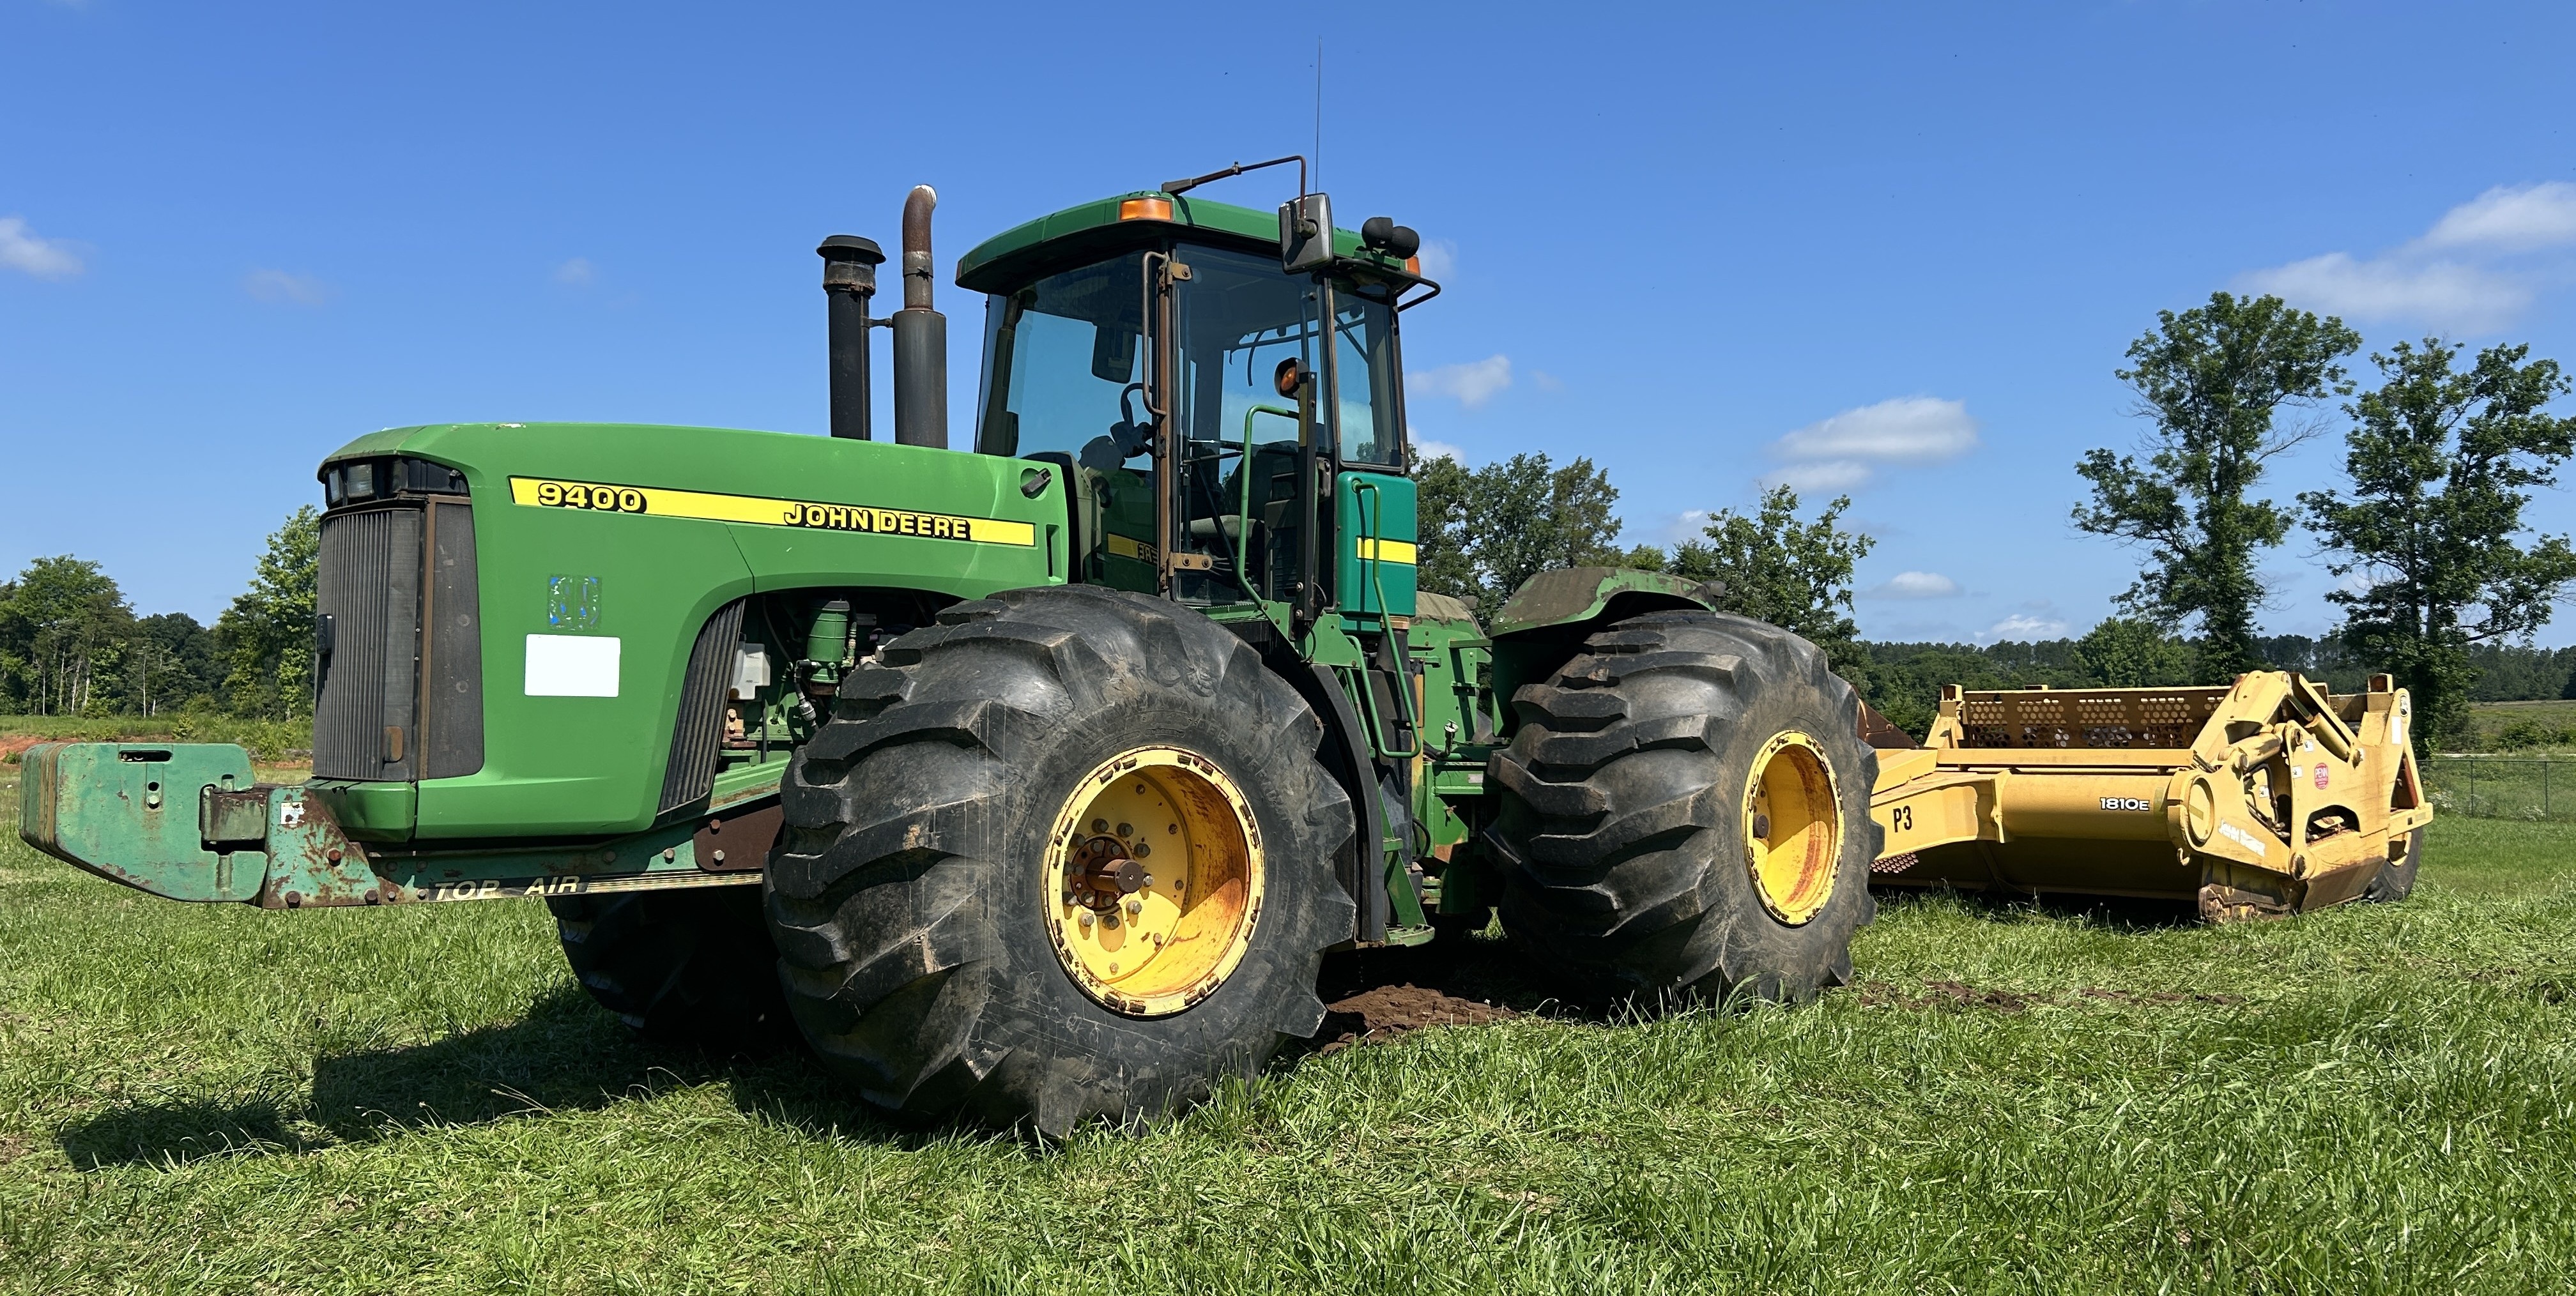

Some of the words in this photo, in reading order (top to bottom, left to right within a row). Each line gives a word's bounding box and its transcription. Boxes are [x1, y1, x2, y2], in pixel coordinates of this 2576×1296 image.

[538, 482, 647, 514] 9400
[784, 504, 871, 531] JOHN
[880, 511, 970, 540] DEERE
[2100, 797, 2150, 811] 1810E
[1892, 805, 1912, 833] P3
[434, 880, 500, 901] TOP
[523, 876, 580, 895] AIR
